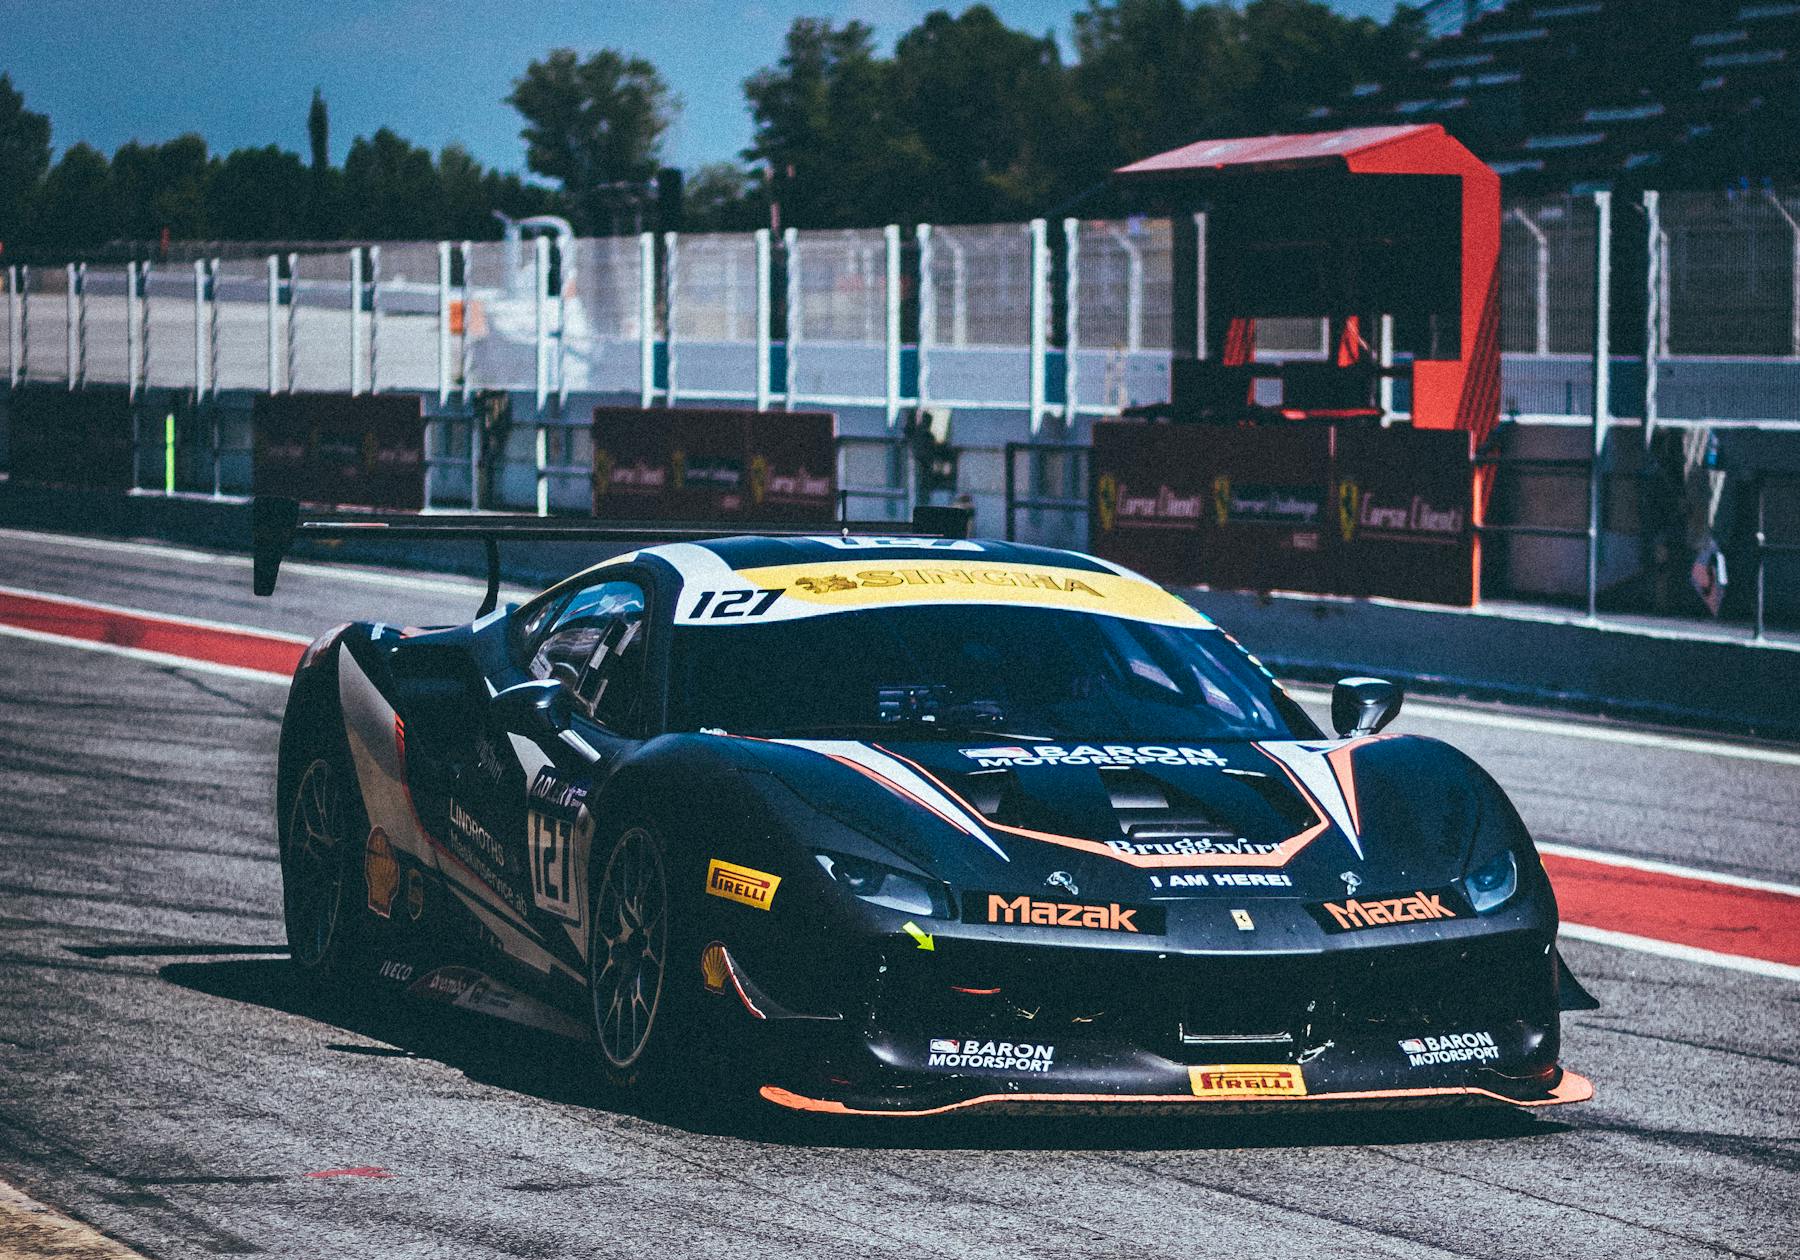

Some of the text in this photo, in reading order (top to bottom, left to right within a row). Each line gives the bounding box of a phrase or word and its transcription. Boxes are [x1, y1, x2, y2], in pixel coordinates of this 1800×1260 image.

[856, 569, 1105, 598] SINGHA
[688, 588, 786, 619] 127
[978, 756, 1228, 767] MOTORSPORT
[1033, 746, 1218, 759] BARON
[711, 867, 770, 902] PIRELLI
[1150, 875, 1163, 888] I
[1169, 874, 1209, 887] AM
[988, 894, 1139, 932] Mazak
[1323, 891, 1457, 929] Mazak
[963, 1040, 1054, 1060] BARON
[1424, 1031, 1494, 1051] BARON
[928, 1054, 1053, 1072] MOTORSPORT
[1408, 1046, 1499, 1067] MOTORSPORT
[1200, 1071, 1294, 1090] PIRELLI
